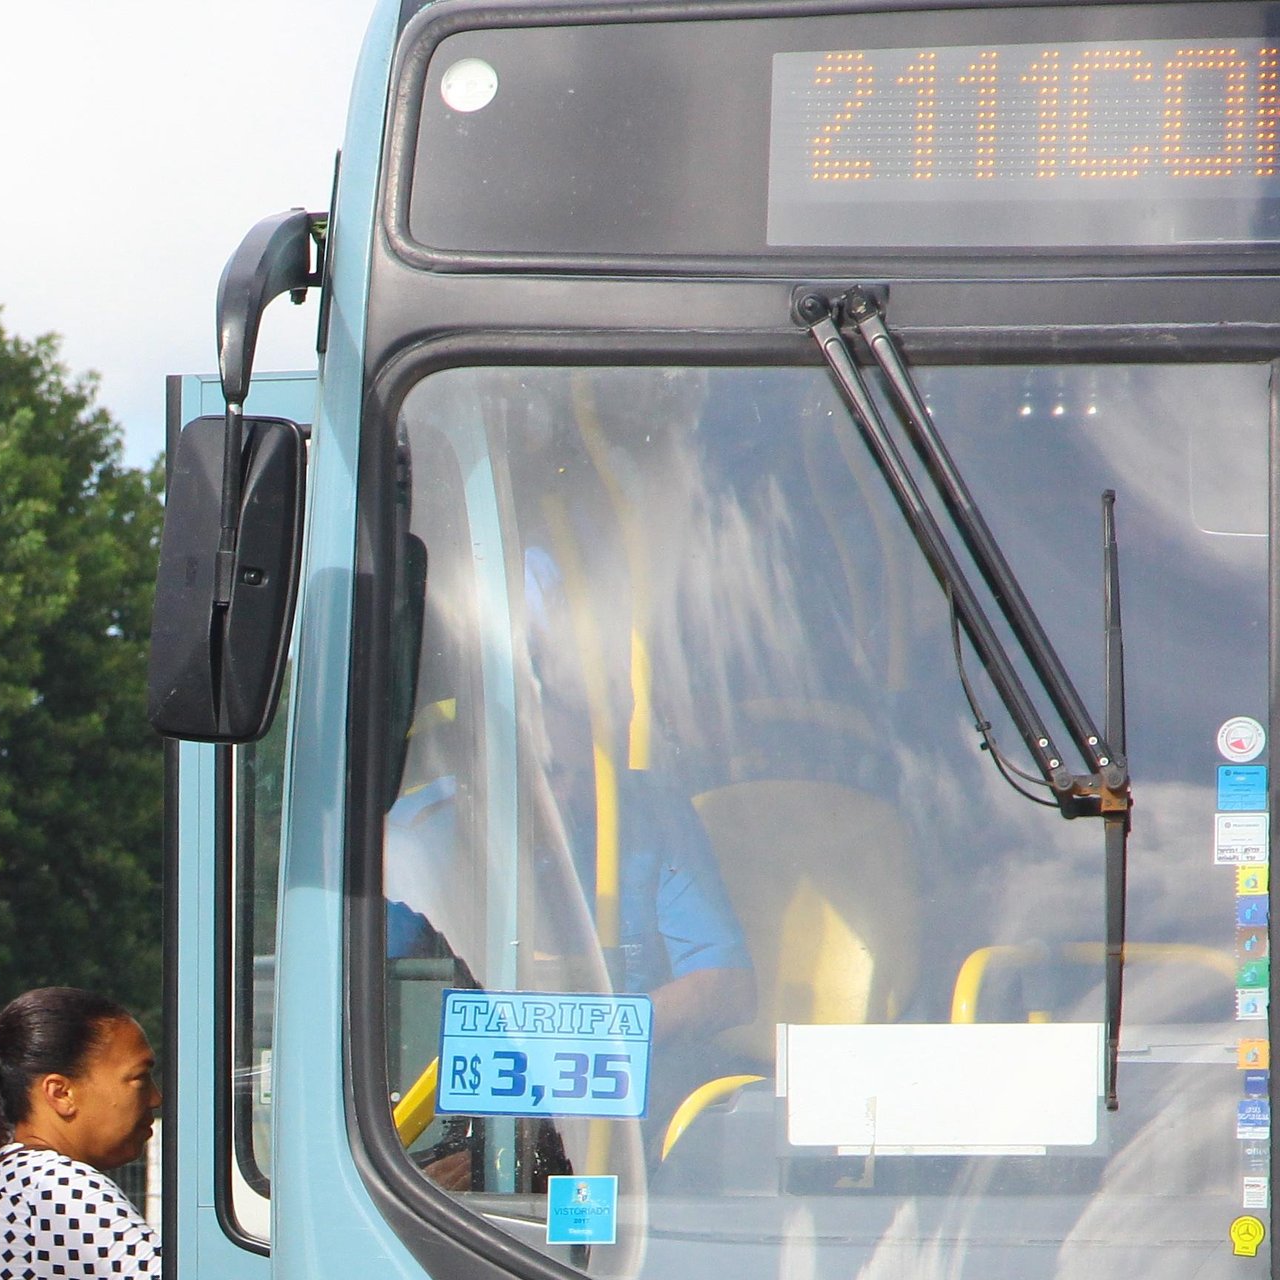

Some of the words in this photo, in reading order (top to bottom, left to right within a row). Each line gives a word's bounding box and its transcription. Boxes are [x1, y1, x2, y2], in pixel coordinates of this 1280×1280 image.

[452, 1000, 643, 1035] TARIFA
[449, 1053, 482, 1096] R$
[490, 1051, 632, 1107] 3,35
